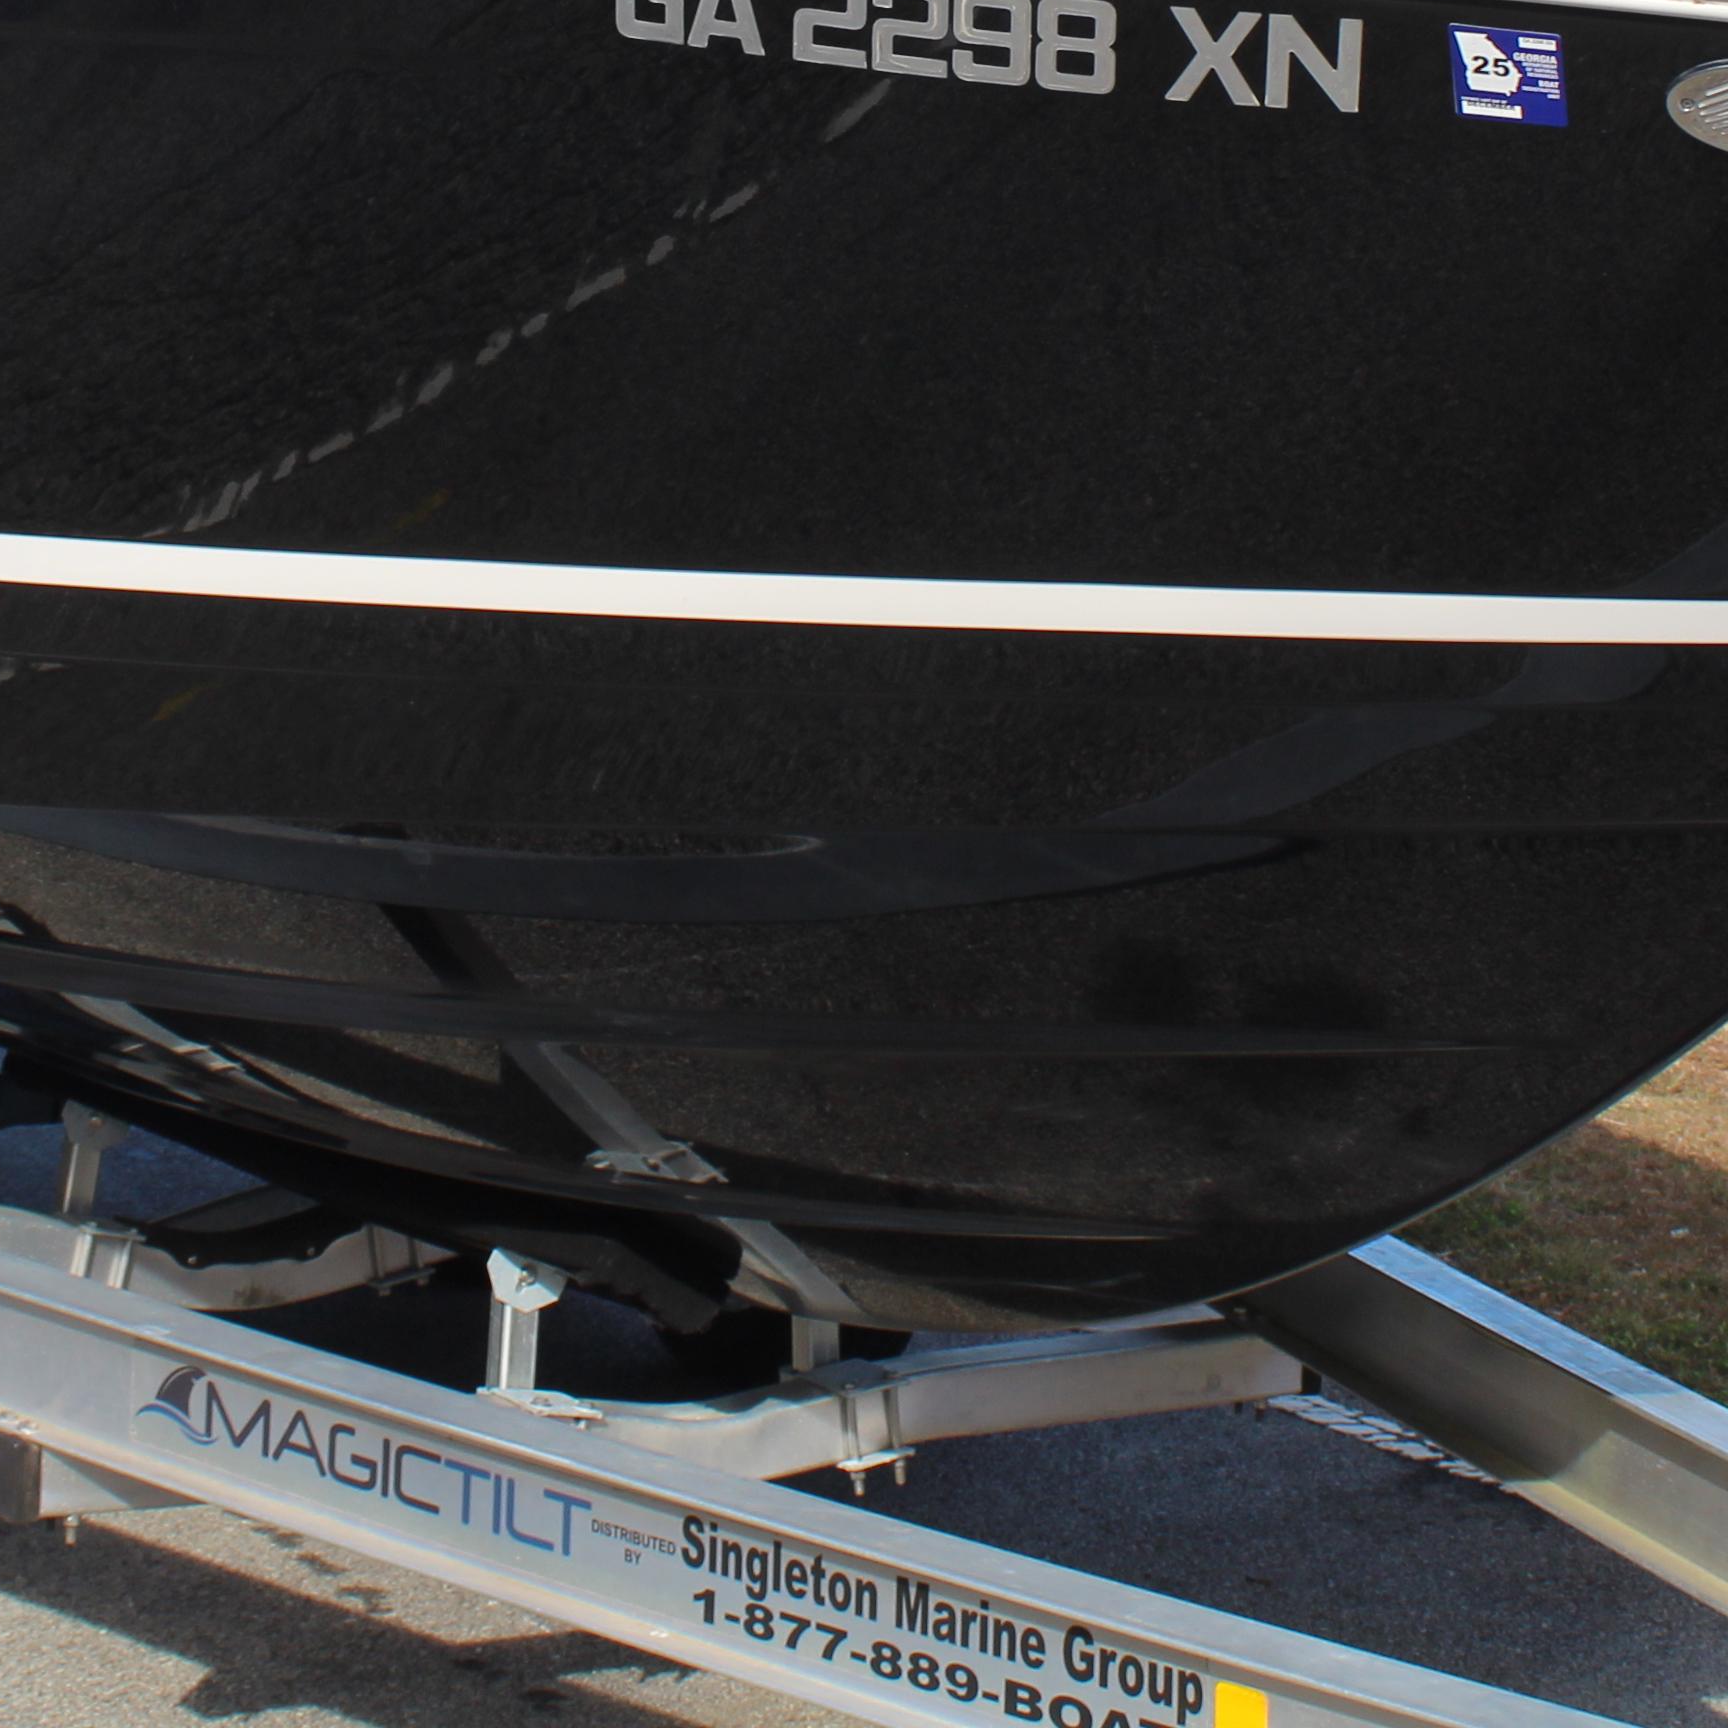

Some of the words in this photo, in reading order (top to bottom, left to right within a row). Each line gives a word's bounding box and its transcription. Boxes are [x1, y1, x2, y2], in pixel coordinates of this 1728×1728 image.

[1164, 5, 1364, 113] XN
[1471, 55, 1511, 77] 25
[1513, 52, 1557, 64] GEORGIA
[204, 1380, 592, 1558] MAGICTILT
[591, 1519, 676, 1556] DISTRIBUTED
[624, 1548, 642, 1565] BY
[681, 1514, 878, 1622] Singleton
[895, 1575, 1046, 1670] Marine
[1063, 1625, 1203, 1726] Group
